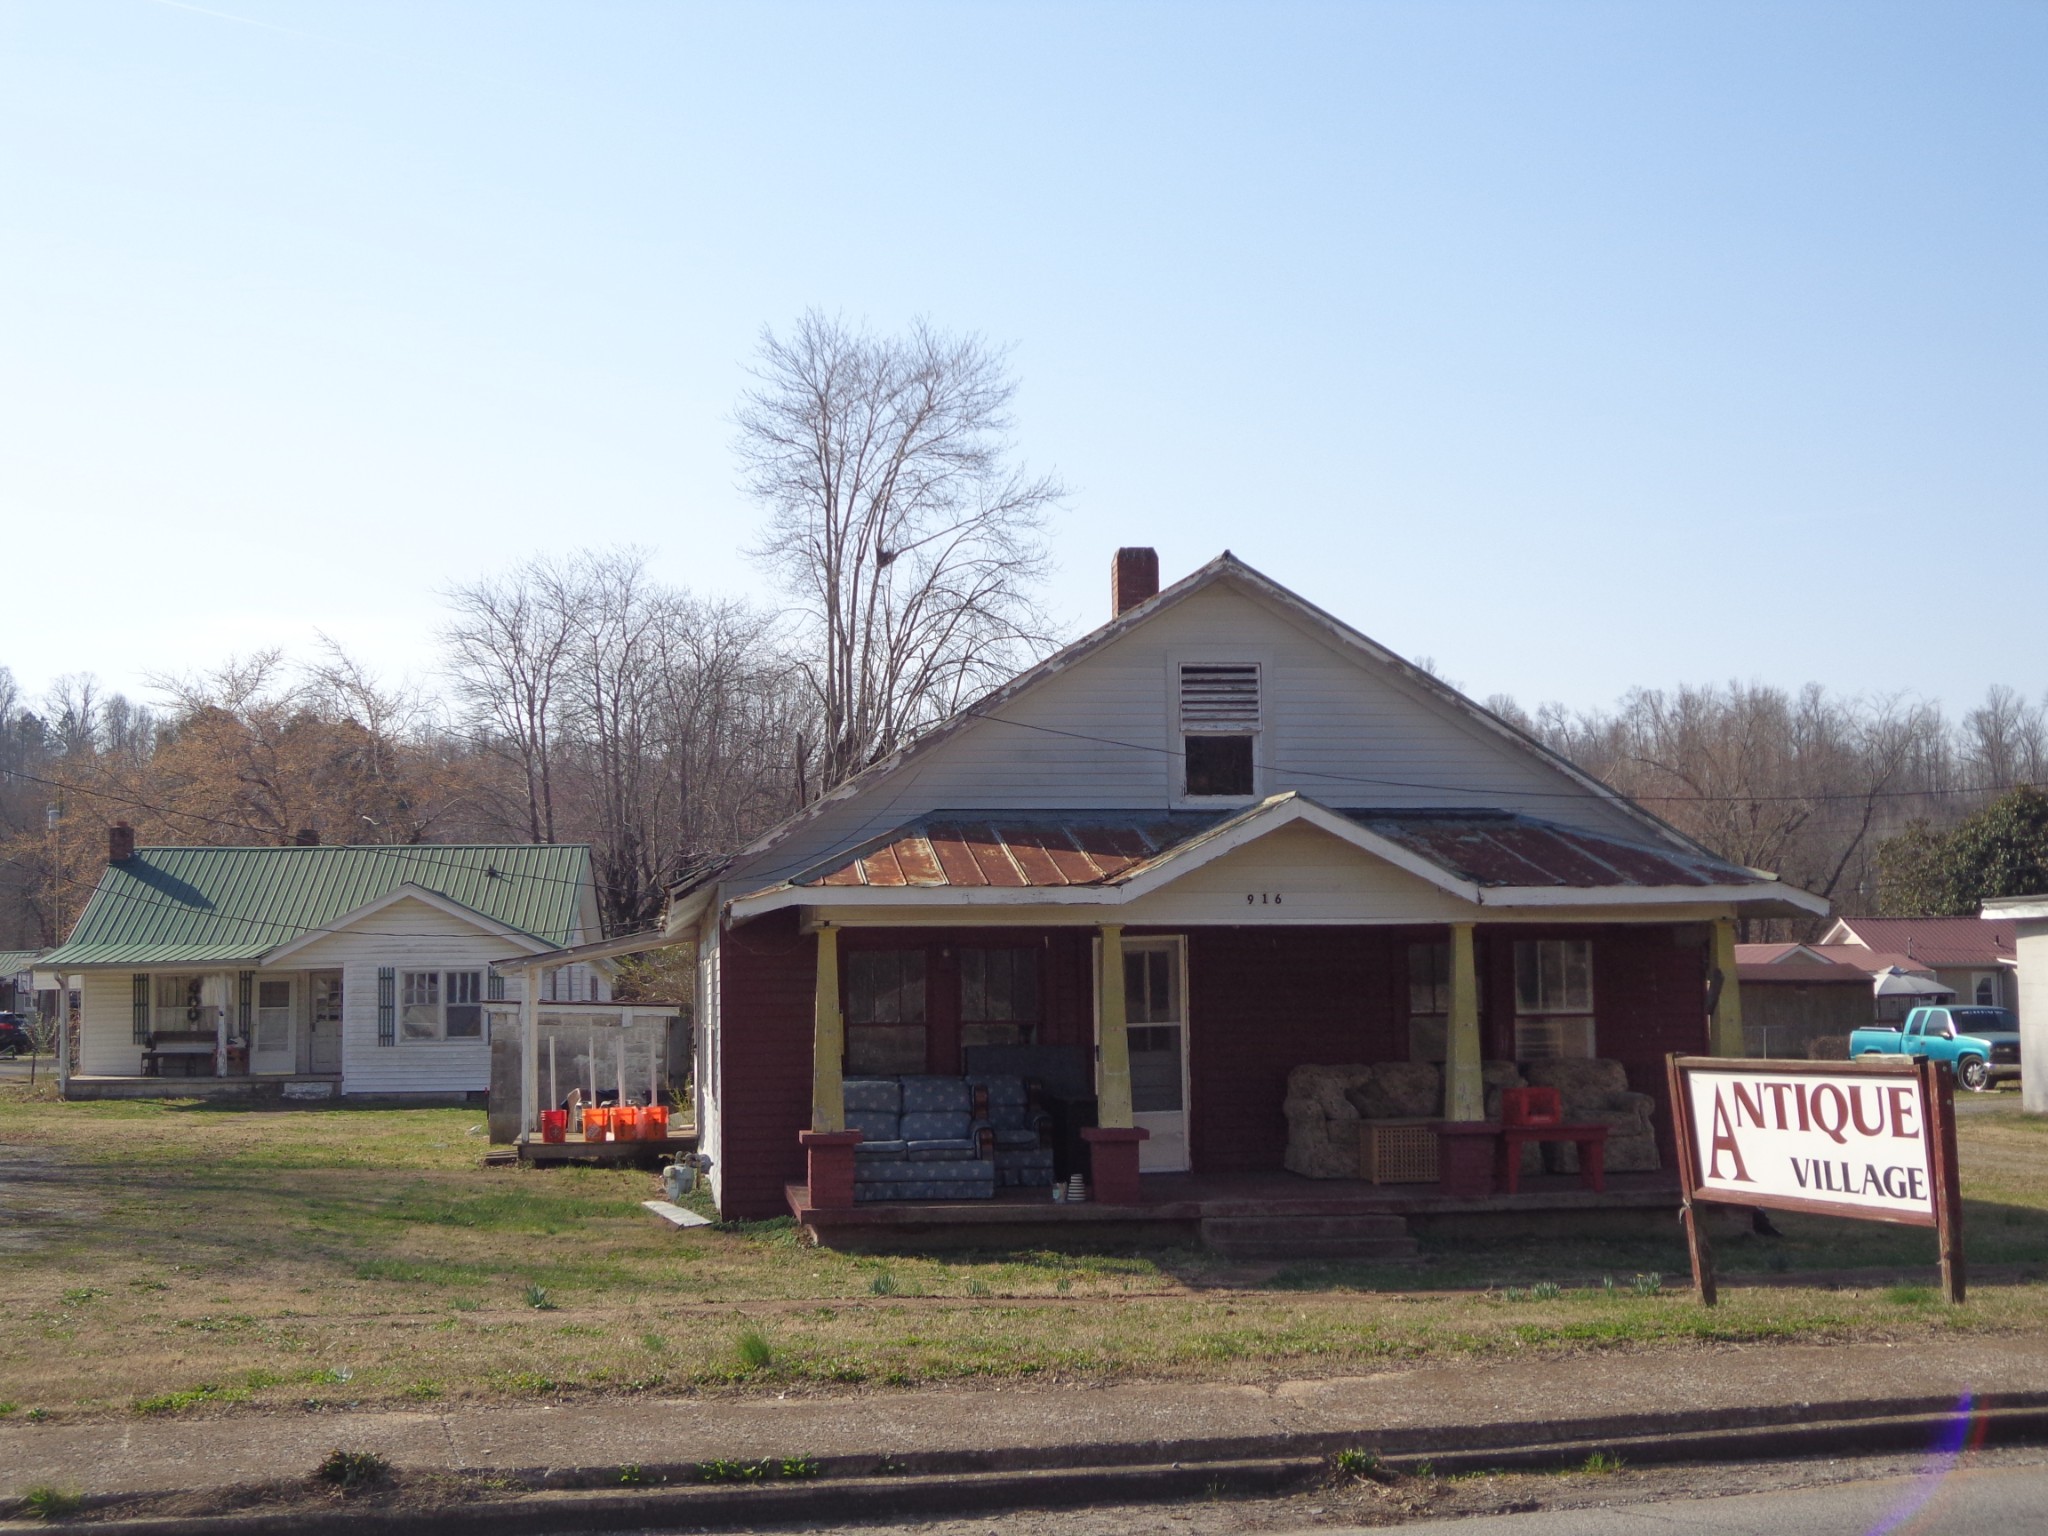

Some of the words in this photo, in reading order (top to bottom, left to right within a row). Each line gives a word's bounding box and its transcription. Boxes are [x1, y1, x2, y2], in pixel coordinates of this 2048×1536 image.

[1247, 893, 1282, 905] 916
[1708, 1081, 1920, 1183] ANTIQUE
[1790, 1157, 1927, 1201] VILLAGE
